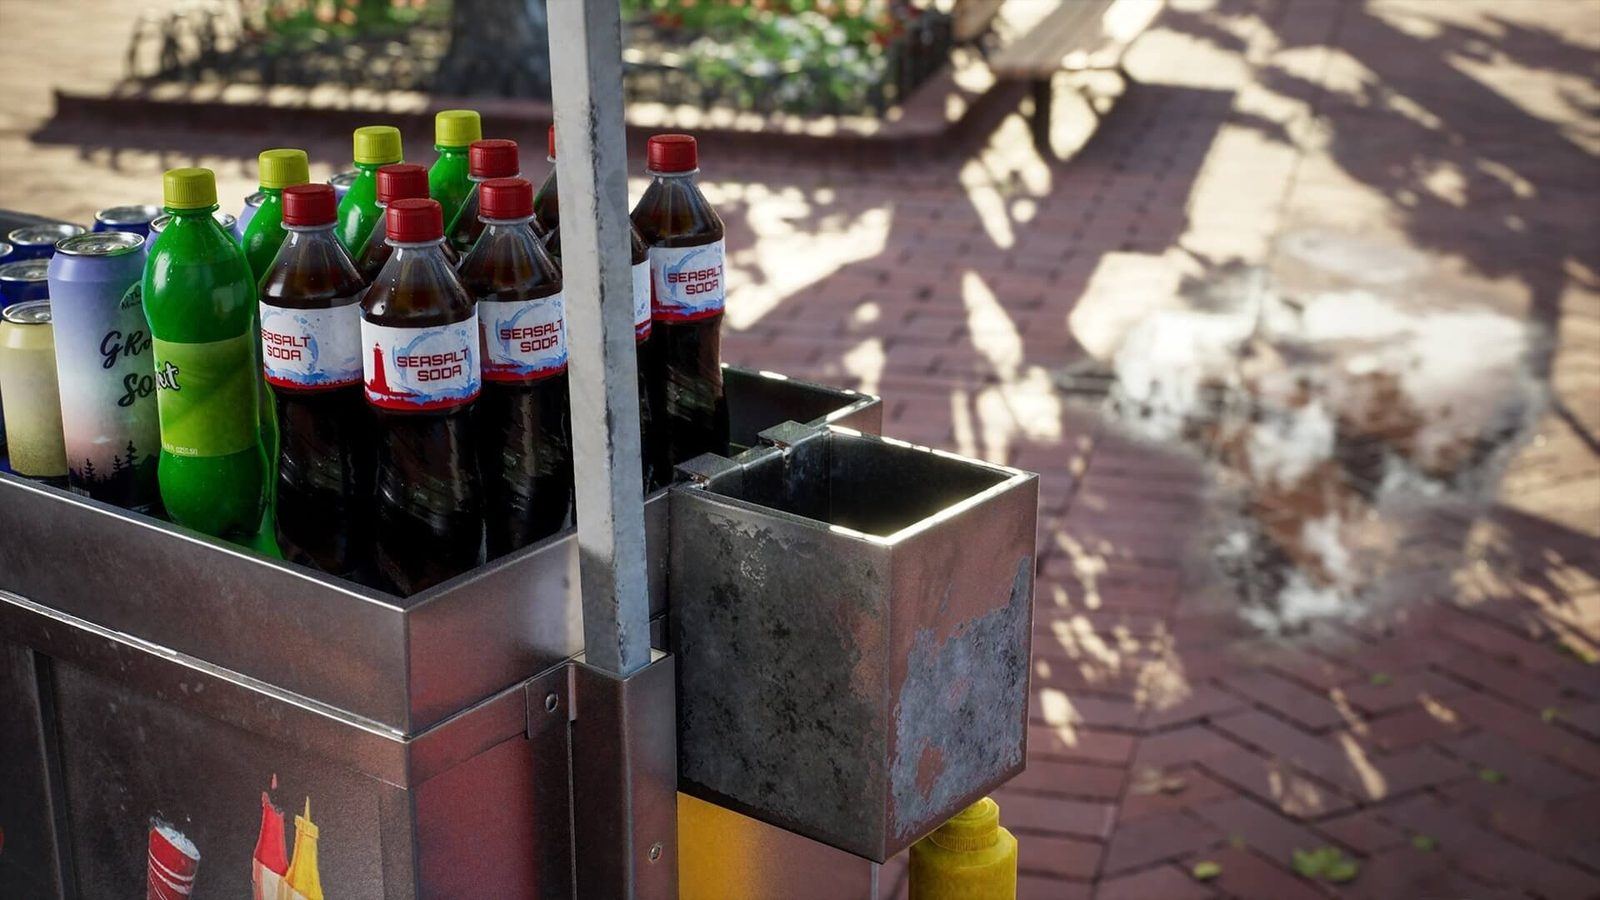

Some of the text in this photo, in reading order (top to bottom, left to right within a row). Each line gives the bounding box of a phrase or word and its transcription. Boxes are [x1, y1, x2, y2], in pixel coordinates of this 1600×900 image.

[668, 264, 722, 283] SEASALT
[686, 279, 718, 295] SODA
[500, 317, 563, 340] SEASALT
[260, 328, 311, 348] EASALT
[521, 335, 558, 353] SODA
[267, 345, 302, 361] SODA
[397, 346, 468, 368] SEASALT
[417, 365, 462, 382] SODA
